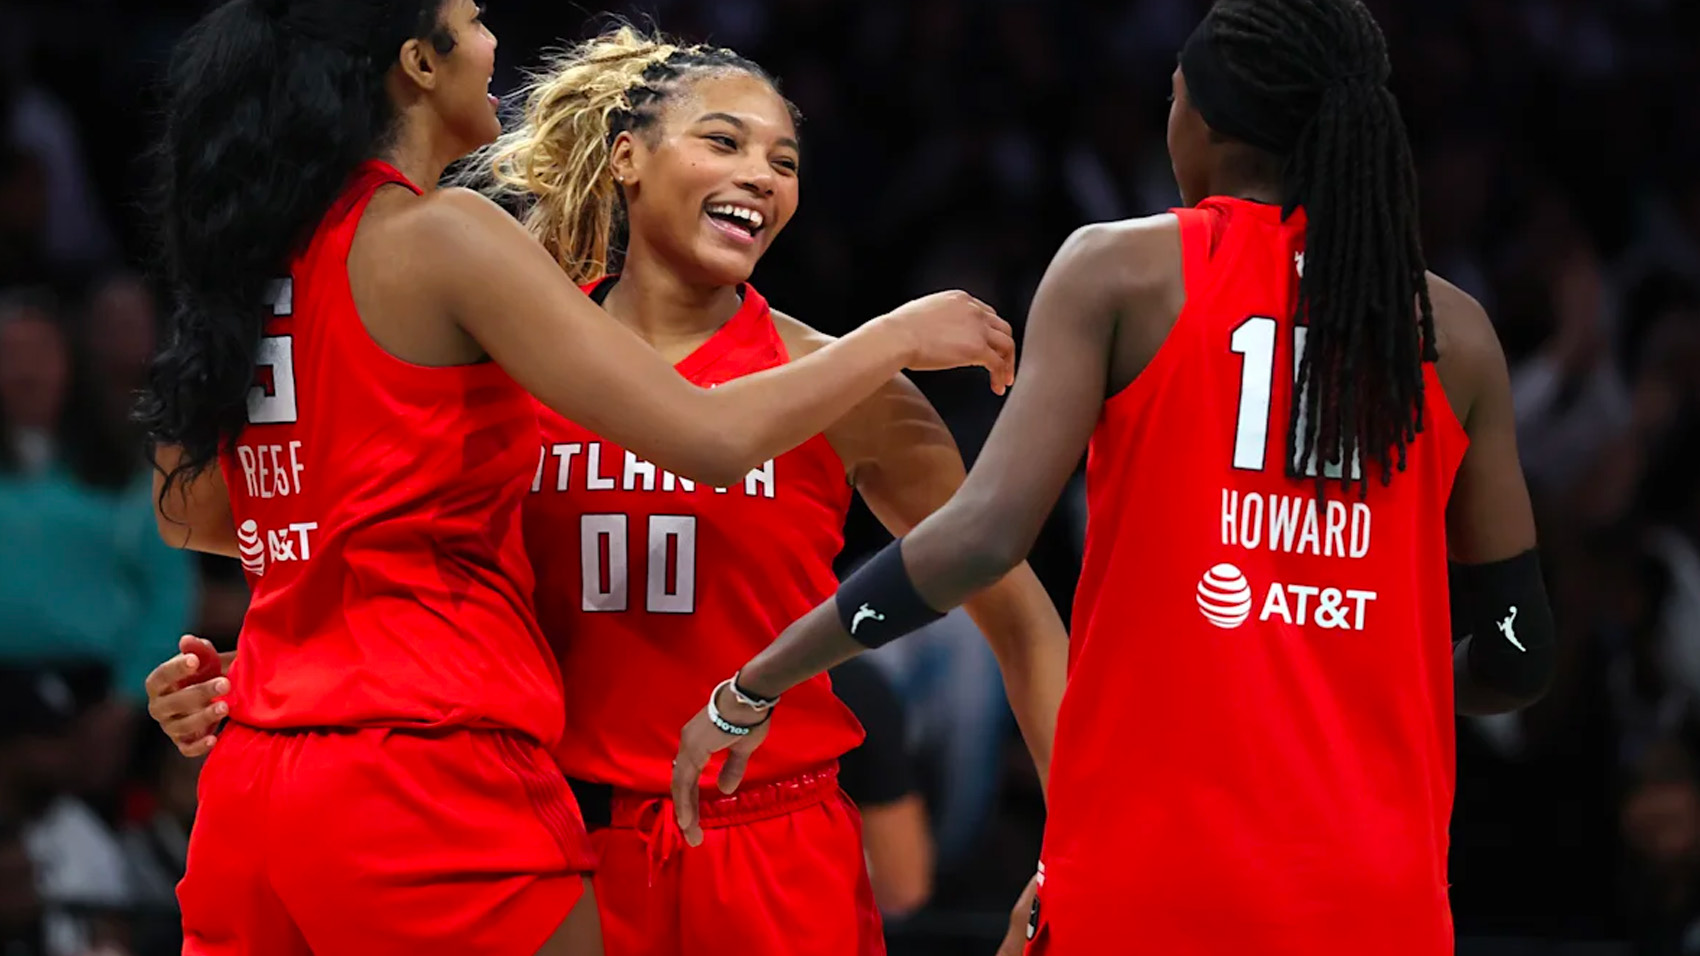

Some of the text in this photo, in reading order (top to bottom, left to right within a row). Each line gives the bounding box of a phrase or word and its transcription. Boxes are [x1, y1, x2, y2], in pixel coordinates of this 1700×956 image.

[1230, 316, 1362, 480] 1
[580, 513, 696, 613] 00
[1221, 488, 1372, 559] HOWARD
[1259, 582, 1377, 630] AT&T
